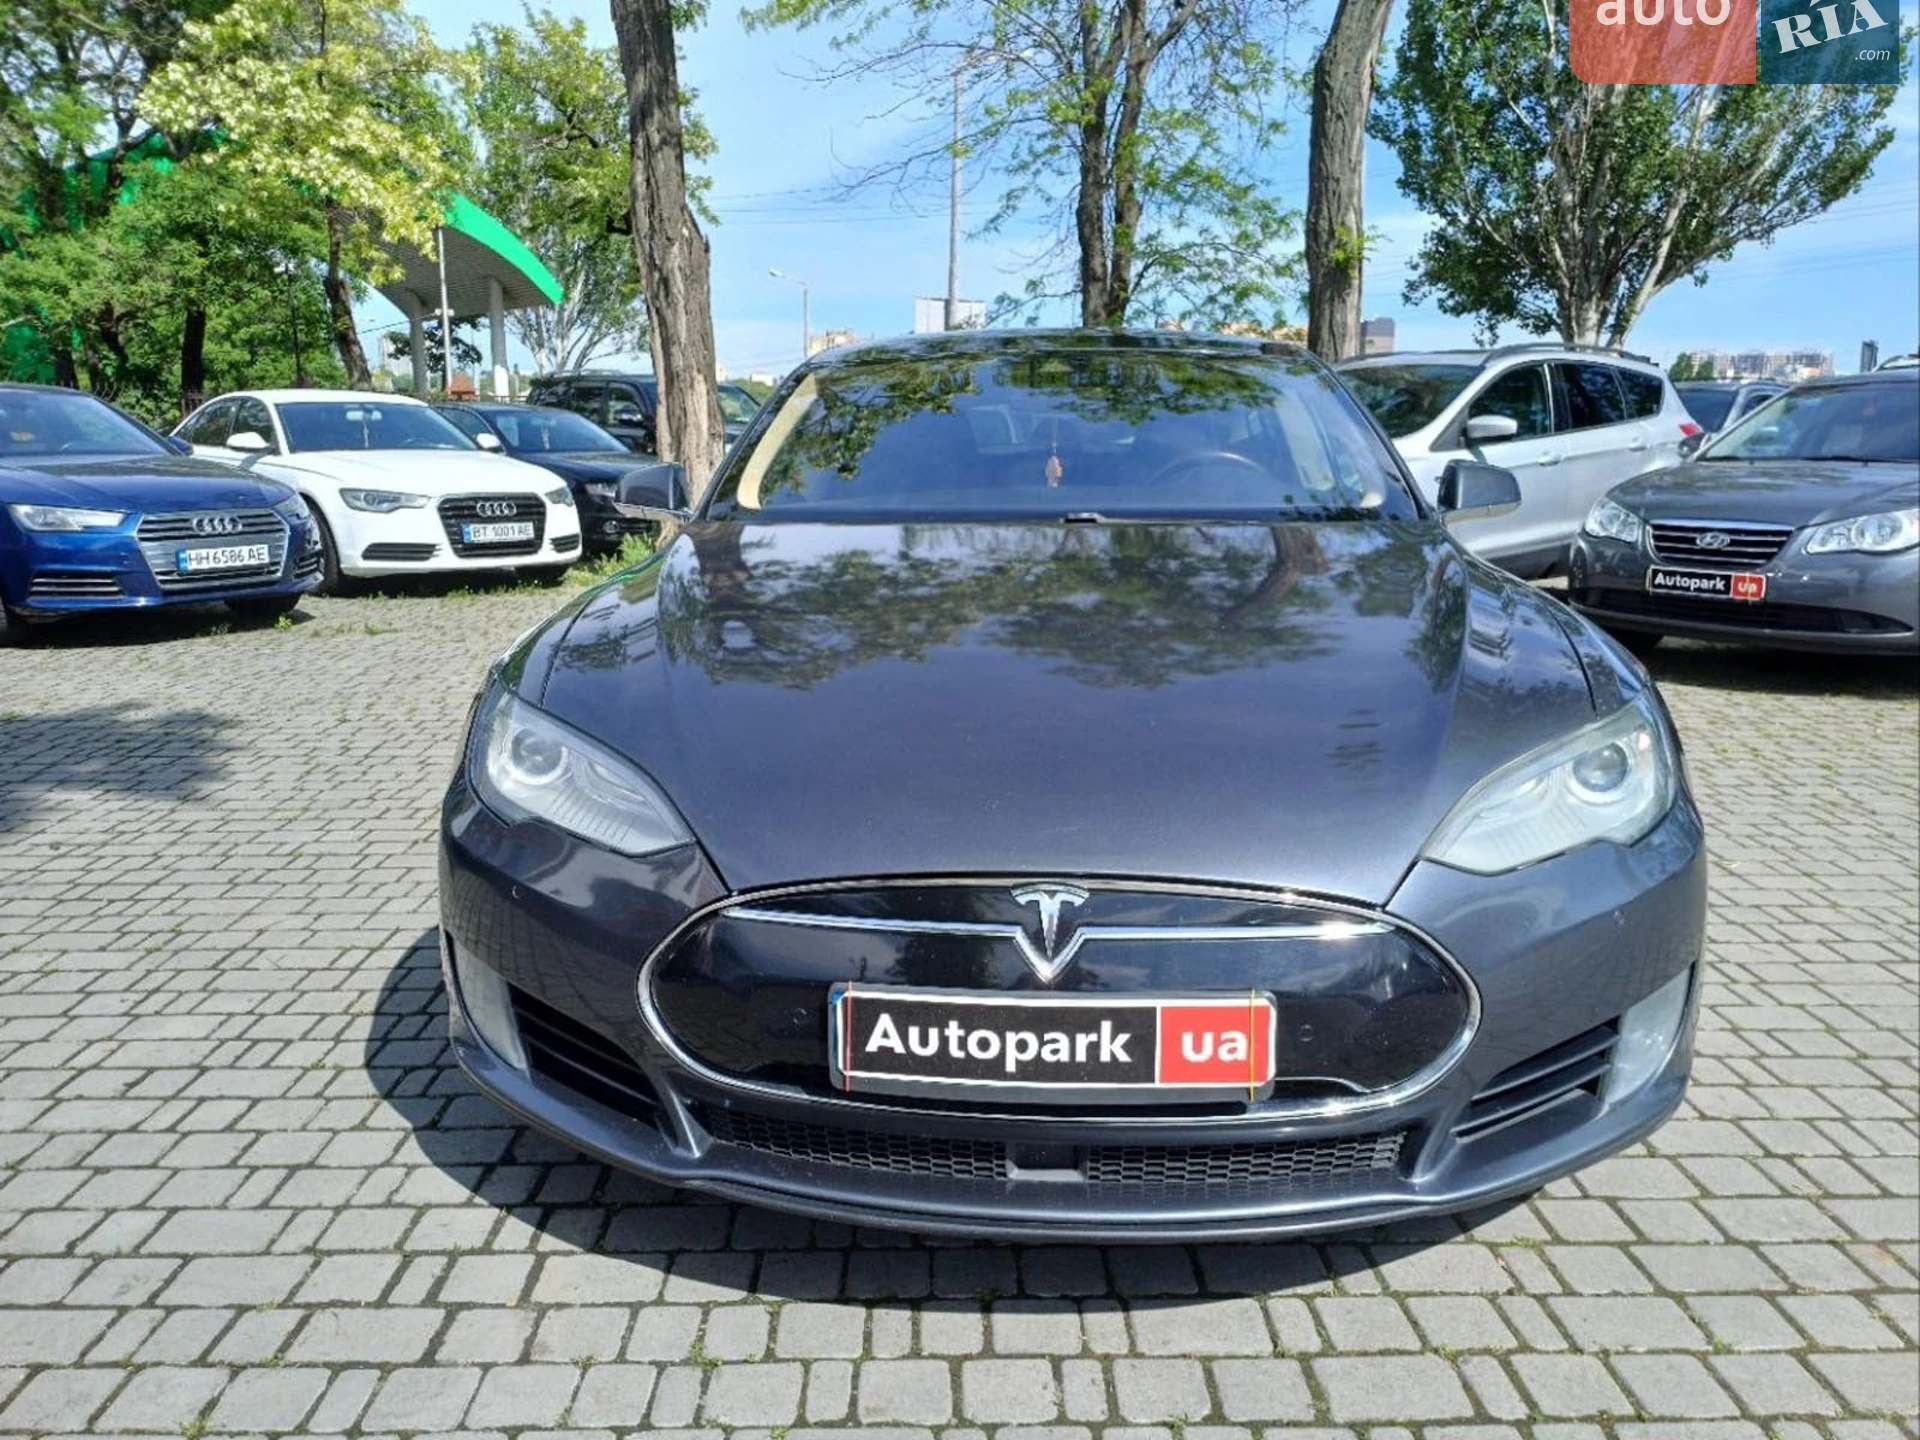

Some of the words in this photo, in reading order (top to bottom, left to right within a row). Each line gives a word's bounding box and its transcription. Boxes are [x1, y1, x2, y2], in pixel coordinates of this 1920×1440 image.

[187, 551, 210, 566] HH
[212, 549, 245, 564] 6586
[247, 546, 266, 562] AE
[1654, 572, 1727, 592] Autopark
[1737, 581, 1758, 593] ua
[864, 1013, 1132, 1073] Autopark
[1180, 1029, 1248, 1063] ua
